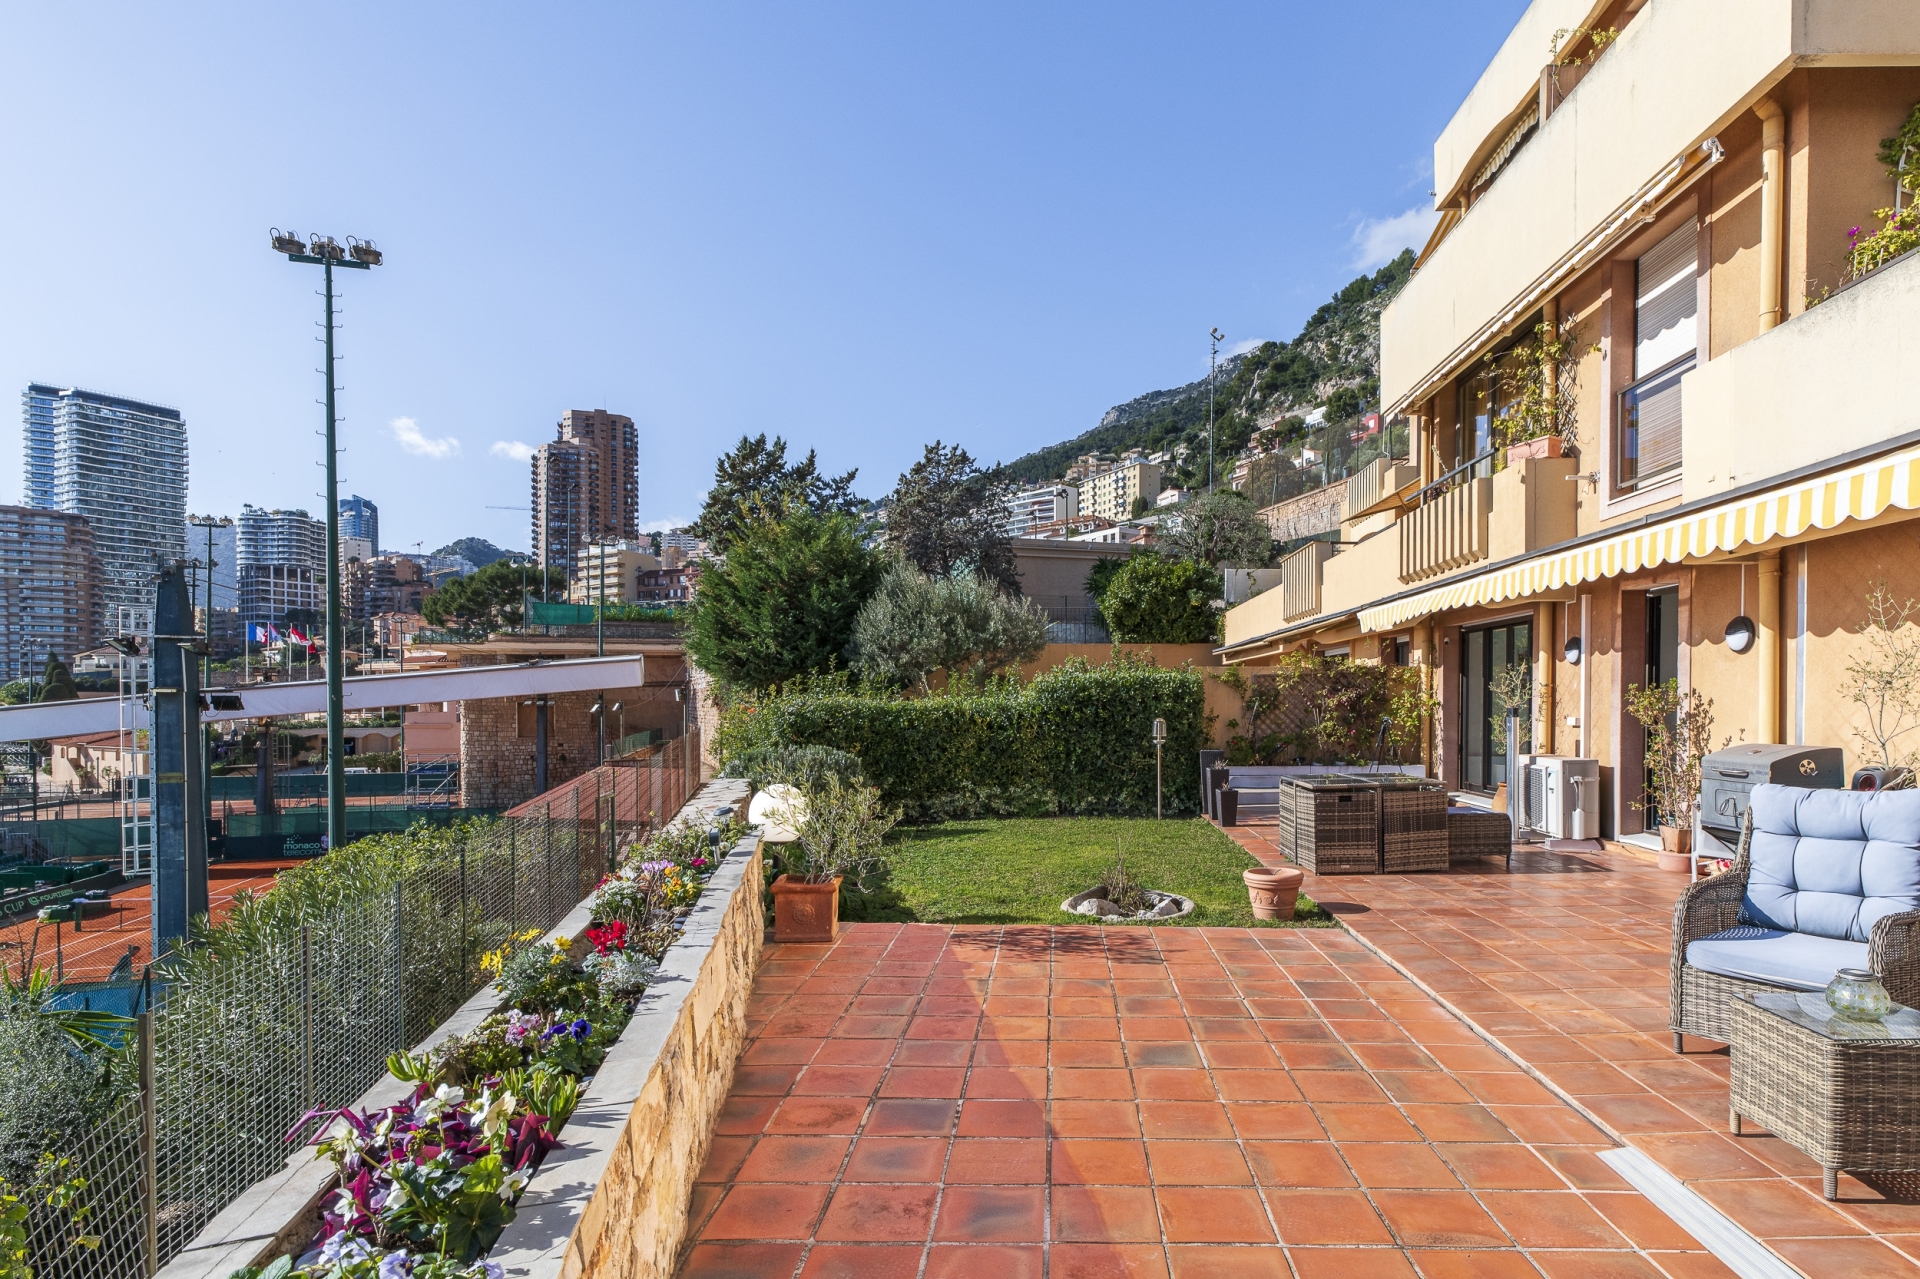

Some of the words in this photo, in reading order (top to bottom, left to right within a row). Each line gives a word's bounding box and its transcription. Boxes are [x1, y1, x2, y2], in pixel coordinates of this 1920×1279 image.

[283, 842, 321, 850] monaco
[283, 848, 321, 856] telecom
[40, 888, 74, 902] FOURTEEN
[4, 901, 24, 914] CUP
